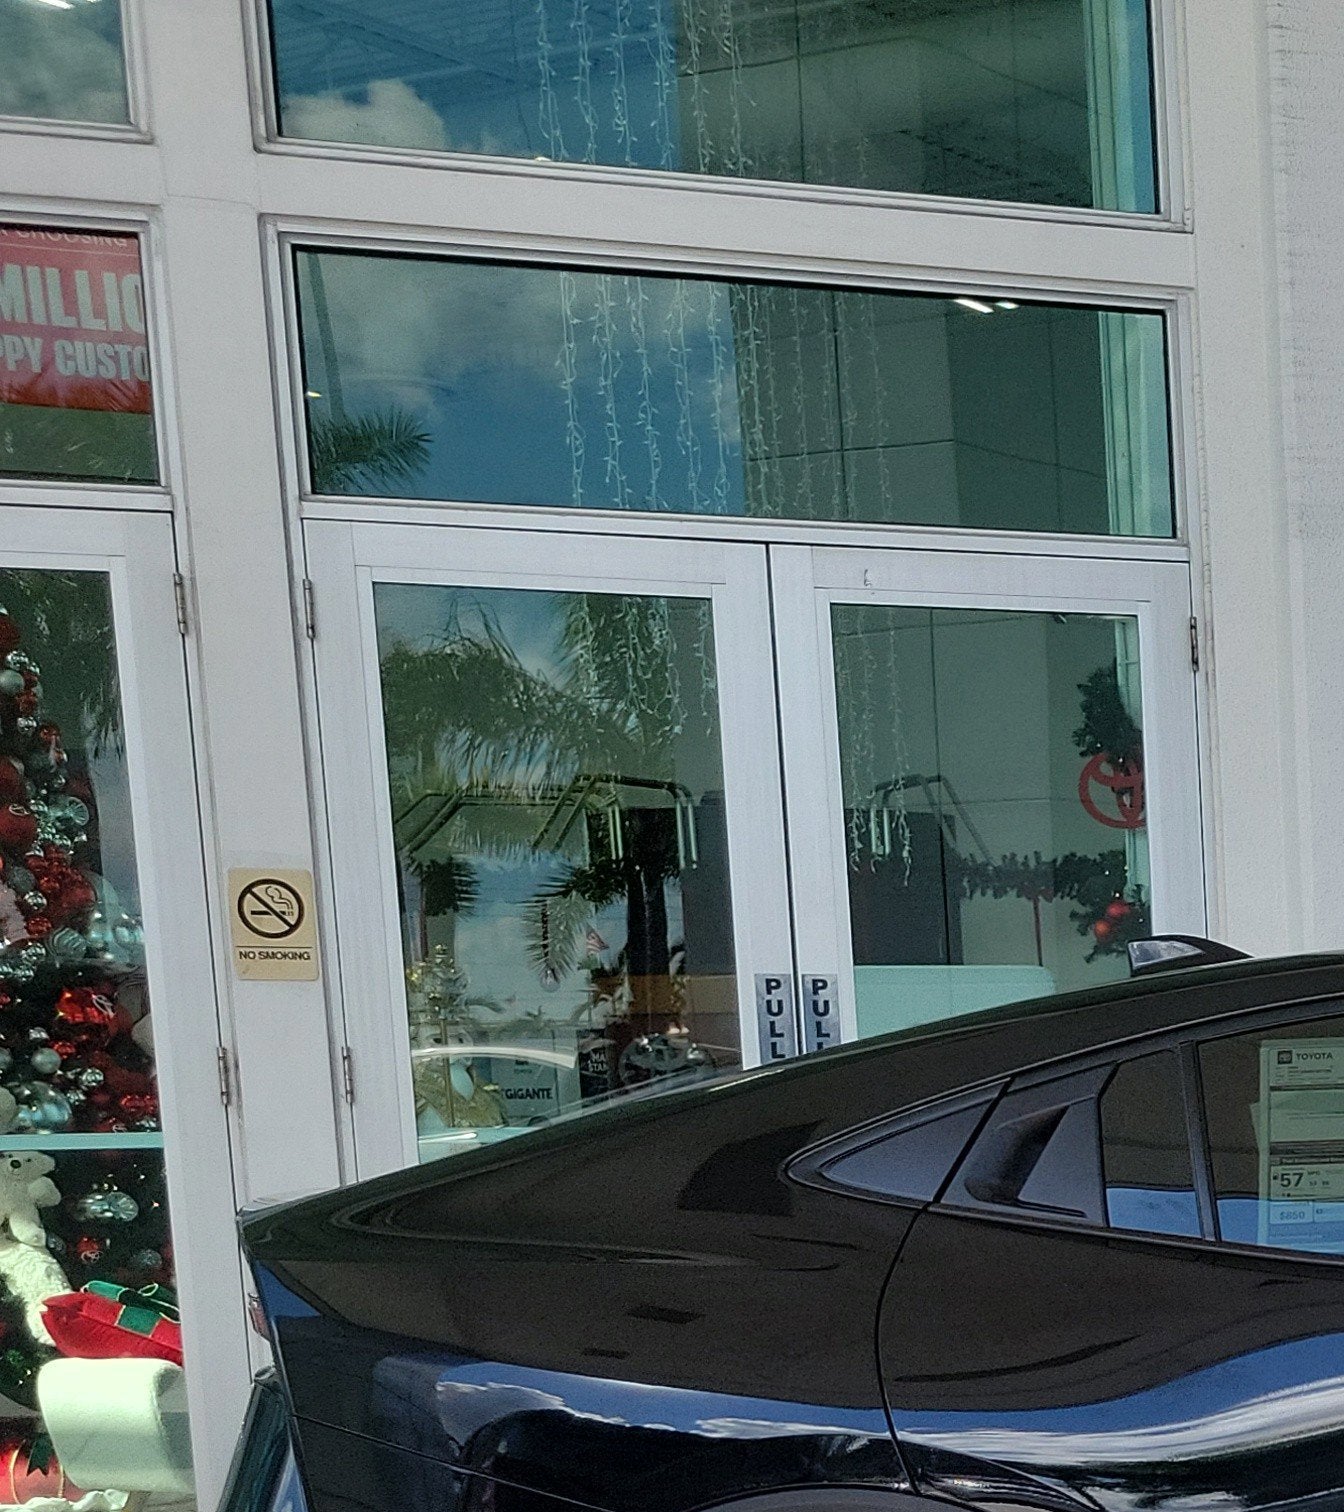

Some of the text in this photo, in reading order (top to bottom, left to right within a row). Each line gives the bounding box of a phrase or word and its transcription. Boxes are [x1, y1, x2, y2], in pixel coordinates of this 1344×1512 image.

[239, 951, 311, 960] NO SMOKING
[765, 978, 786, 1059] PULL
[1296, 1052, 1333, 1060] TOYOTA
[505, 1088, 553, 1099] GIGANTE
[1280, 1172, 1304, 1188] 57
